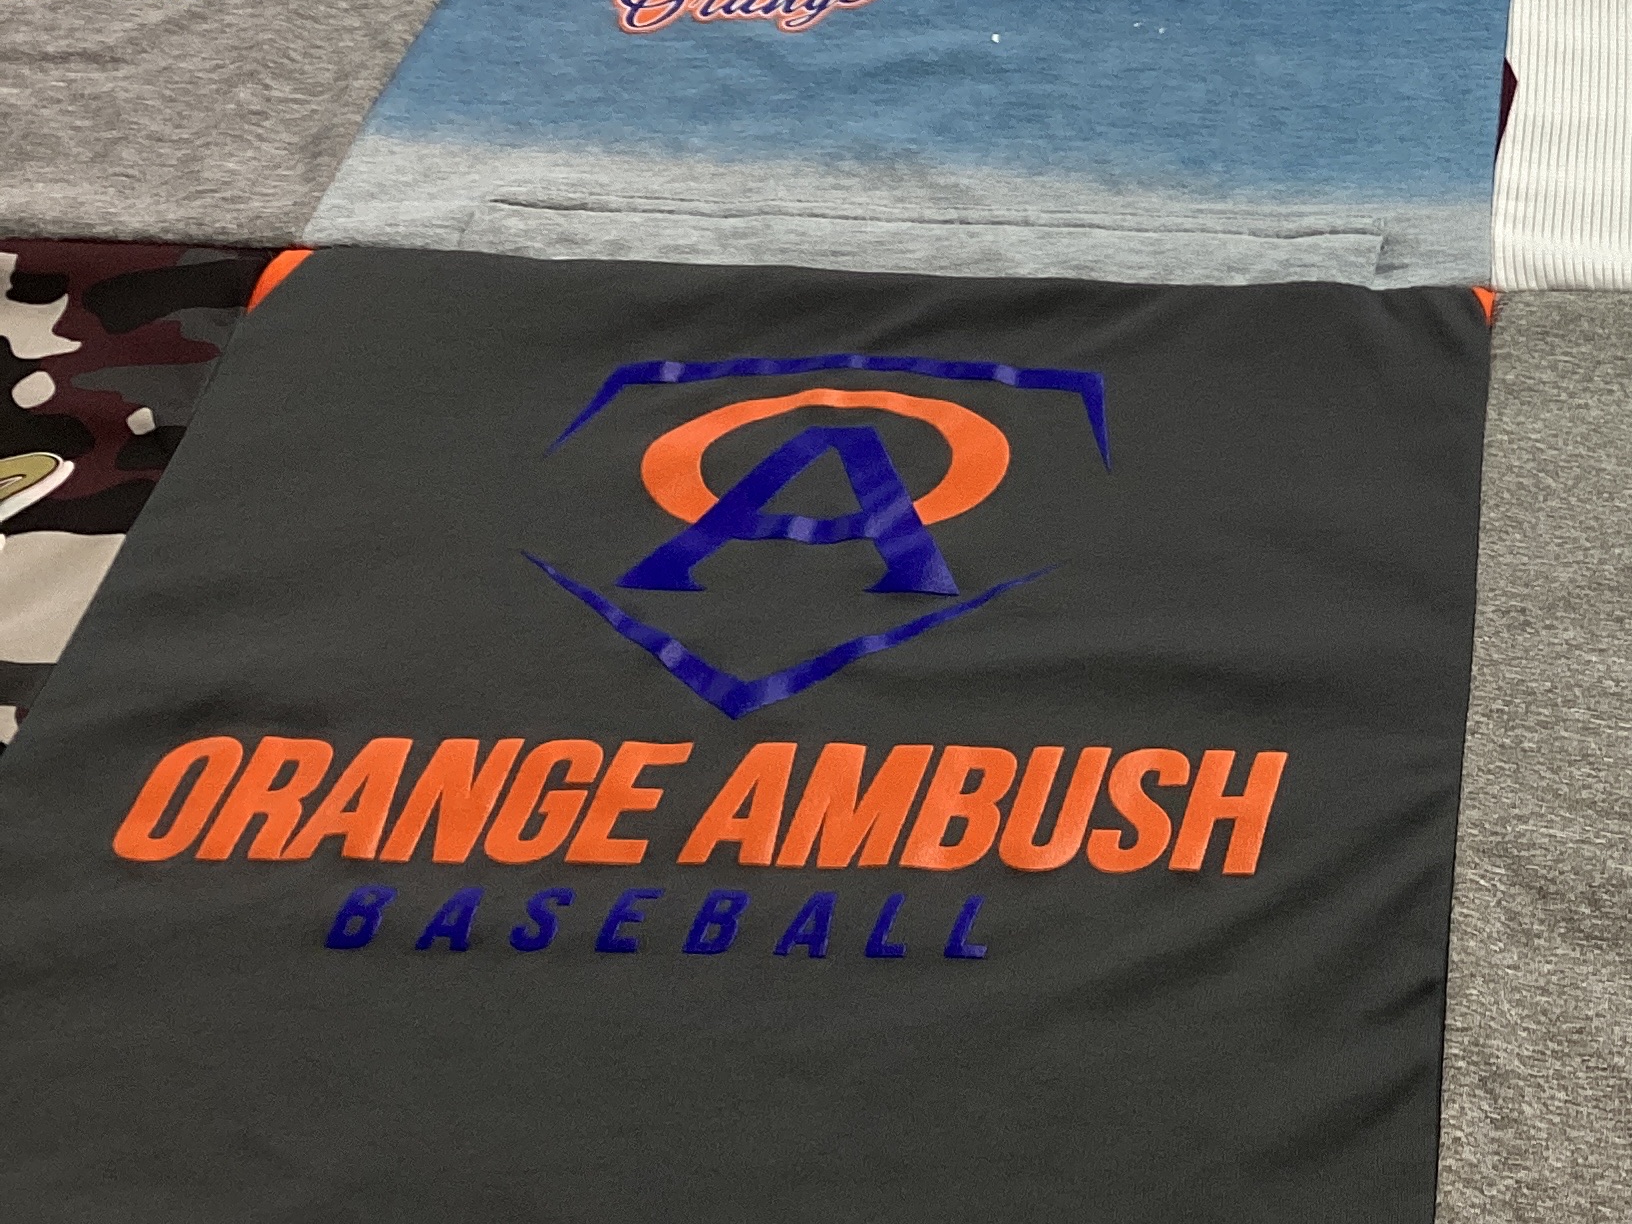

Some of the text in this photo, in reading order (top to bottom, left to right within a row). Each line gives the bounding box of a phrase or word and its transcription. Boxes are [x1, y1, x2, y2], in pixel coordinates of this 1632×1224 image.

[112, 736, 1289, 877] ORANGE AMBUSH
[324, 884, 990, 960] BASEBALL
